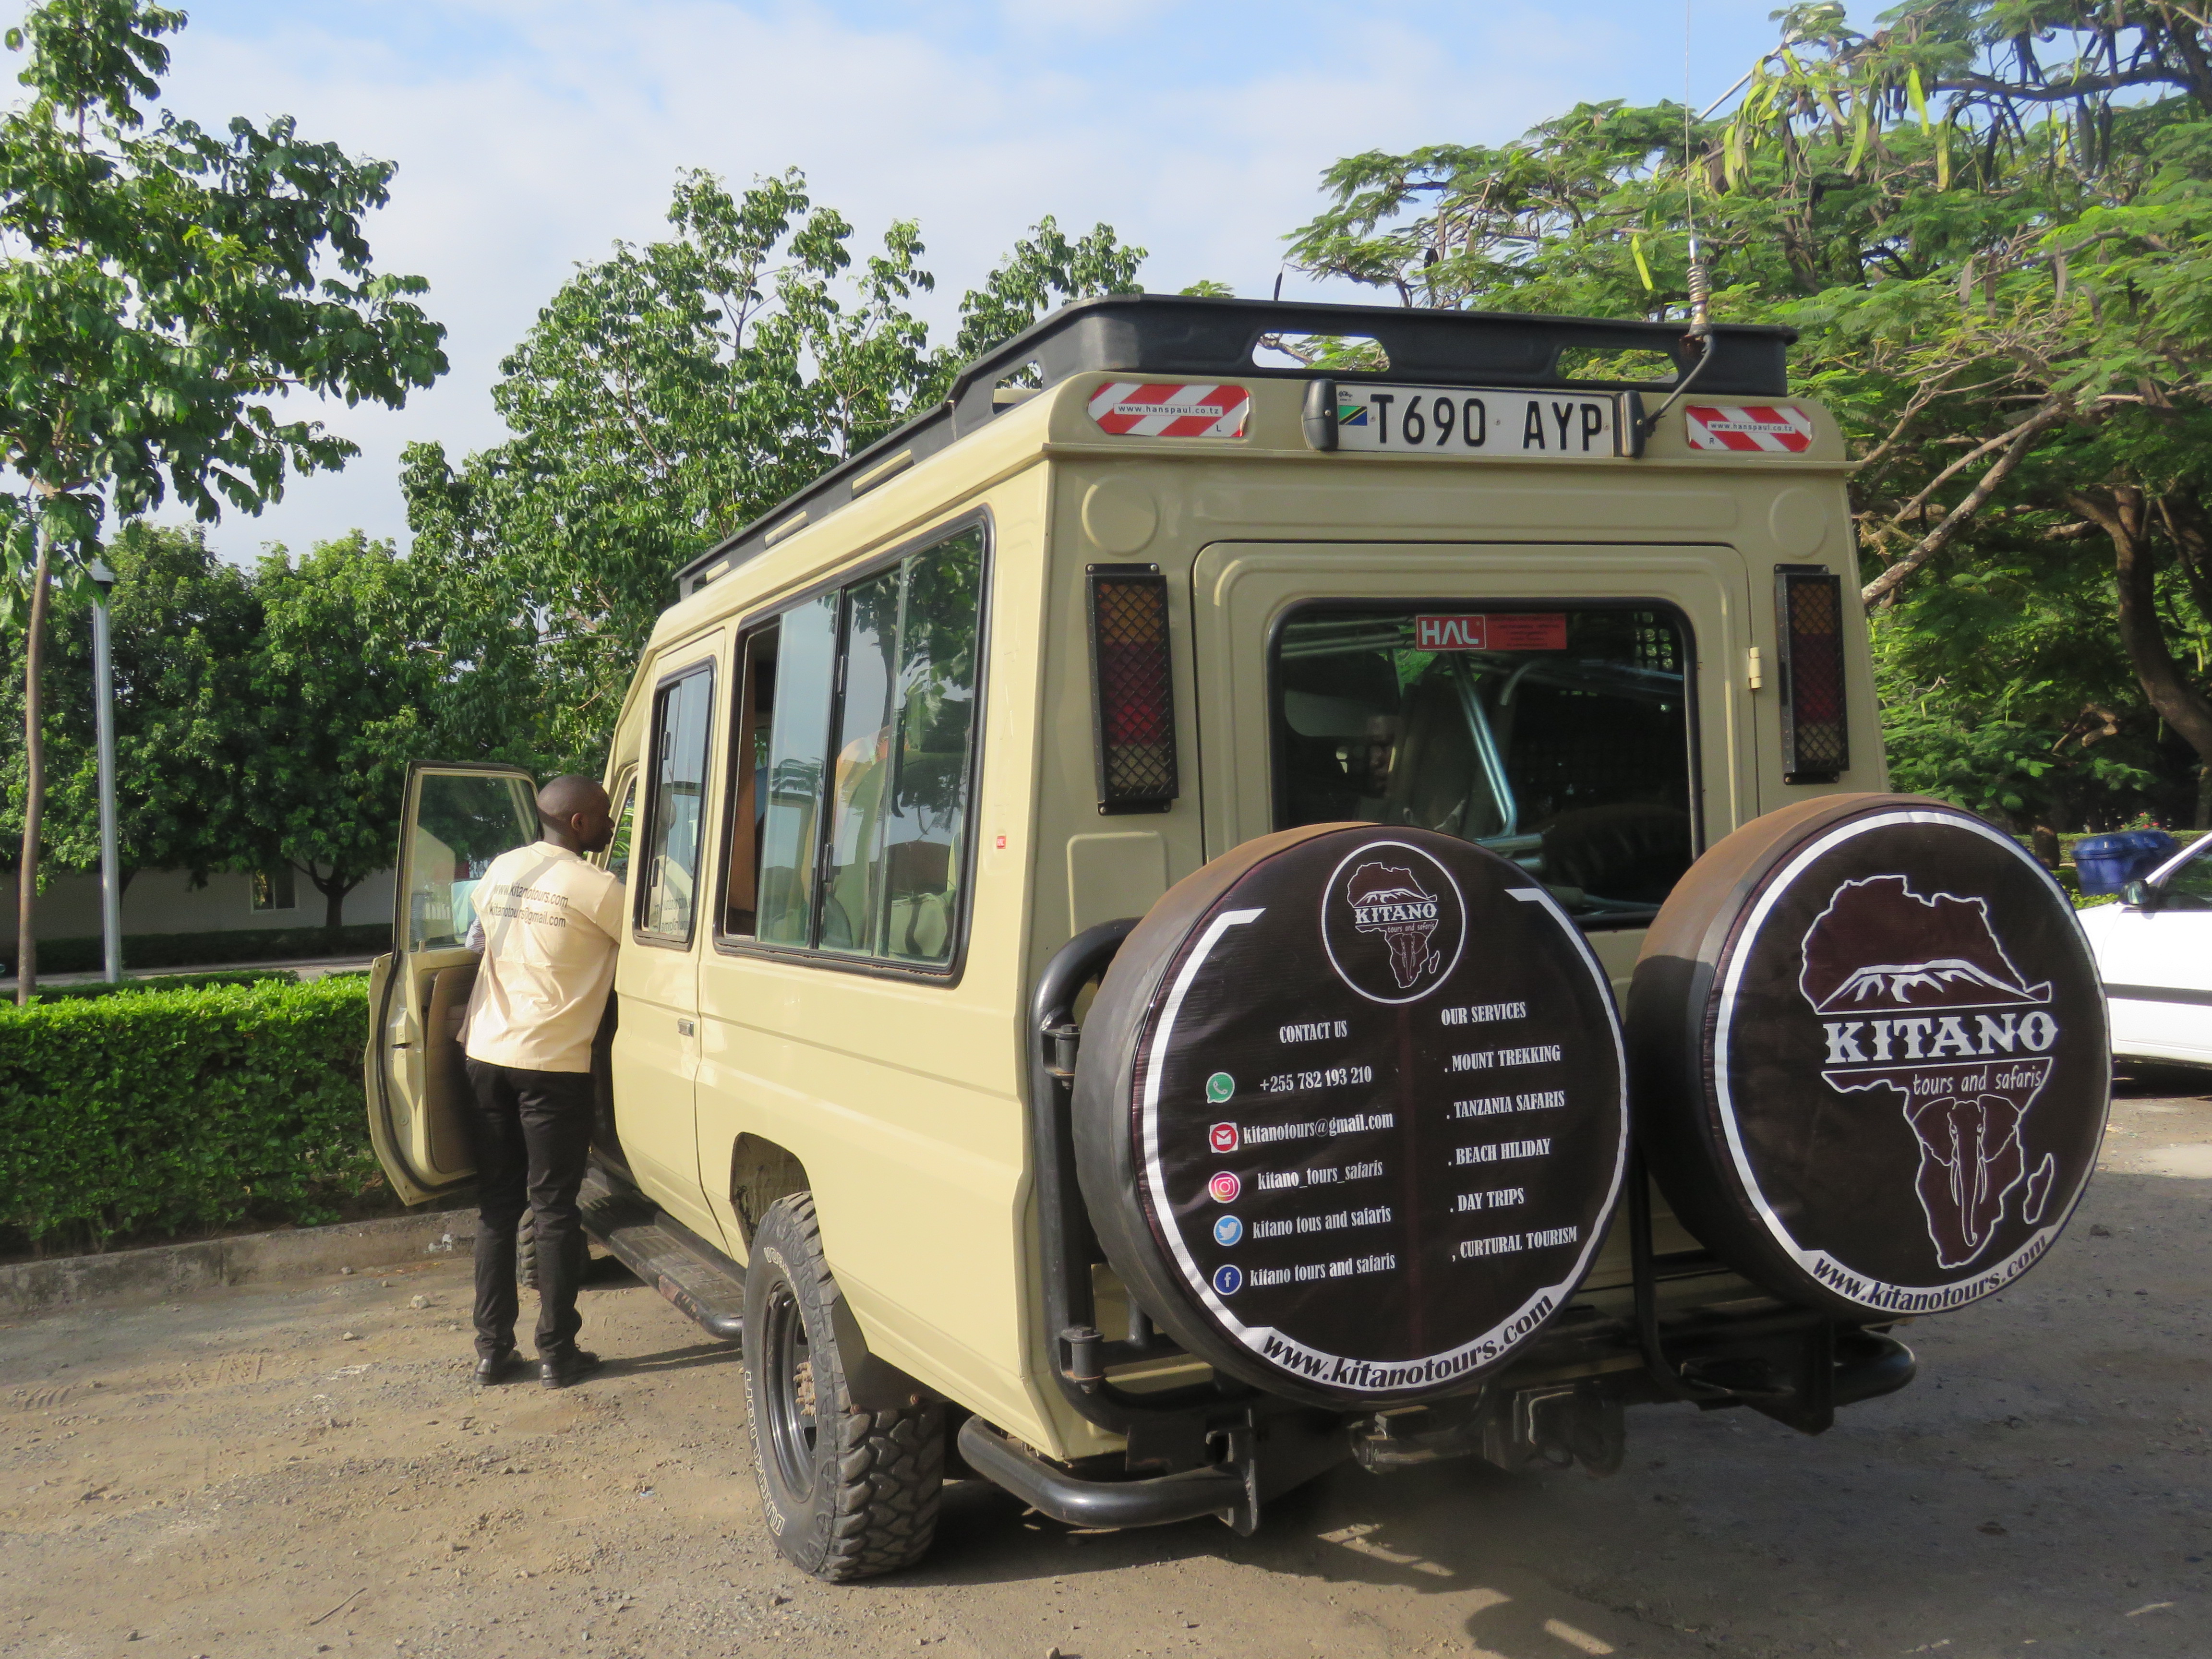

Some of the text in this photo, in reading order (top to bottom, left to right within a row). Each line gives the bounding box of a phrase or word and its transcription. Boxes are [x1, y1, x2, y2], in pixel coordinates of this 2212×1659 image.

[1118, 406, 1219, 415] www.hanspaul.co.tz
[1370, 394, 1602, 451] T690 AYP
[1710, 422, 1792, 432] www.hanspaul.co.tz
[1421, 620, 1479, 645] HAL
[493, 880, 568, 908] www.kitanotours.com
[489, 902, 566, 928] kitanotours@gmail.com
[1354, 903, 1437, 924] KITANO
[1405, 923, 1415, 931] and
[1417, 922, 1434, 930] safaris
[1441, 1001, 1526, 1025] OUR SERVICES
[1279, 1020, 1347, 1044] CONTACT US
[1823, 1011, 2058, 1064] KITANO
[1452, 1045, 1561, 1072] MOUNT TREKKING
[1260, 1065, 1372, 1093] +255 782 193 210
[1913, 1065, 2041, 1095] tours and safaris
[1454, 1090, 1565, 1118] TANZANIA SAFARIS
[1243, 1112, 1394, 1144] kitanotours@gmail.com
[1455, 1138, 1551, 1165] BEACH HILIDAY
[1257, 1160, 1383, 1190] kitano_tours_safaris
[1457, 1187, 1525, 1212] DAY TRIPS
[1252, 1205, 1391, 1239] kitano tous and safaris
[1460, 1226, 1577, 1258] CURTURAL TOURISM
[1250, 1252, 1396, 1286] kitano tours and safaris
[1812, 1234, 2046, 1311] www.kitanotours.com
[1262, 1295, 1553, 1388] www.kitanotours.com
